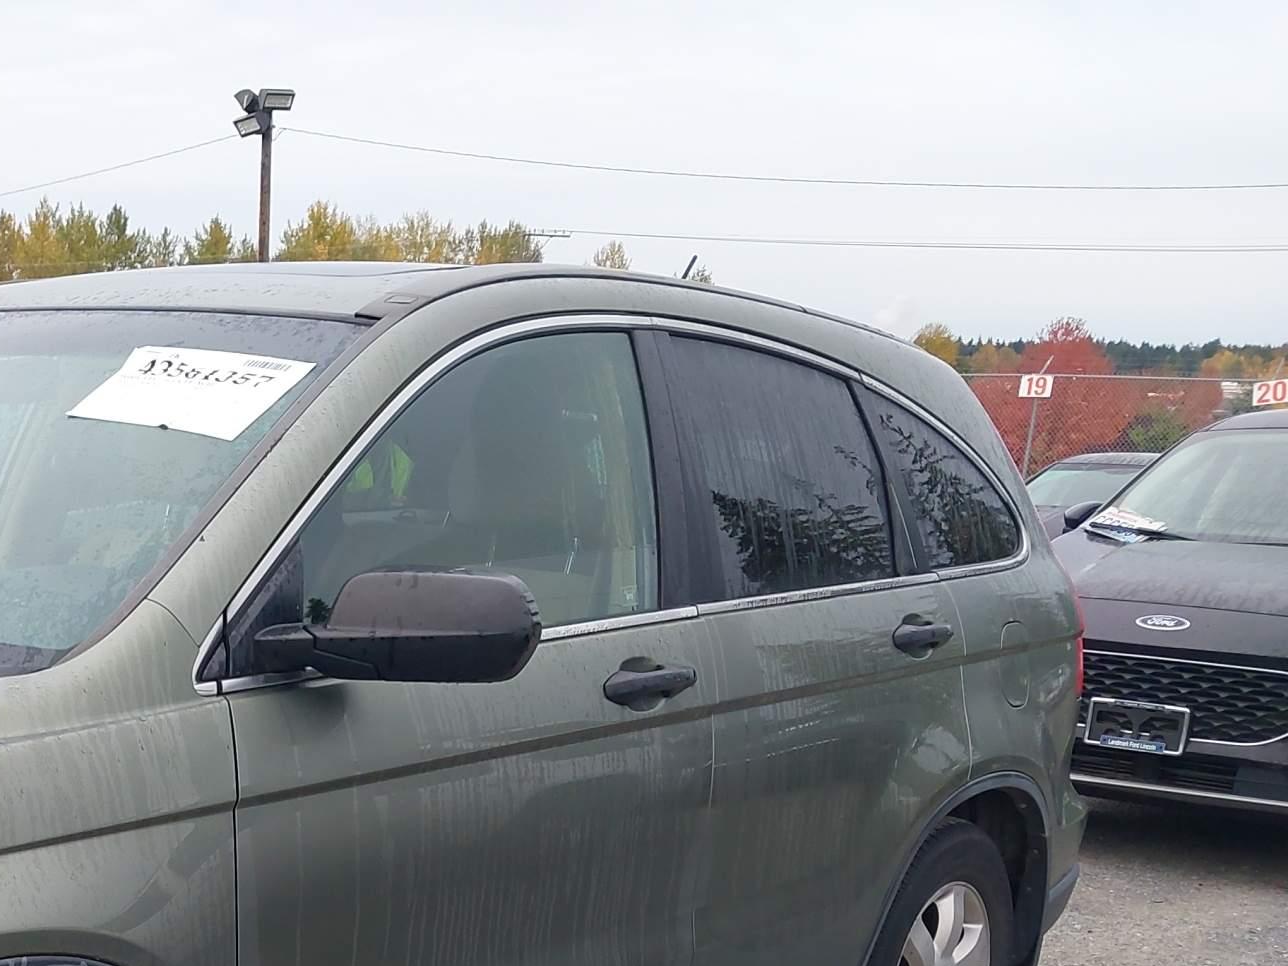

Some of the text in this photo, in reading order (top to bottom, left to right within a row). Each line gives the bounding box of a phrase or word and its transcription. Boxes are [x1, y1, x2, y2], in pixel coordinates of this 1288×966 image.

[1026, 376, 1047, 395] 19
[1256, 383, 1288, 404] 20
[1129, 741, 1140, 749] Ford
